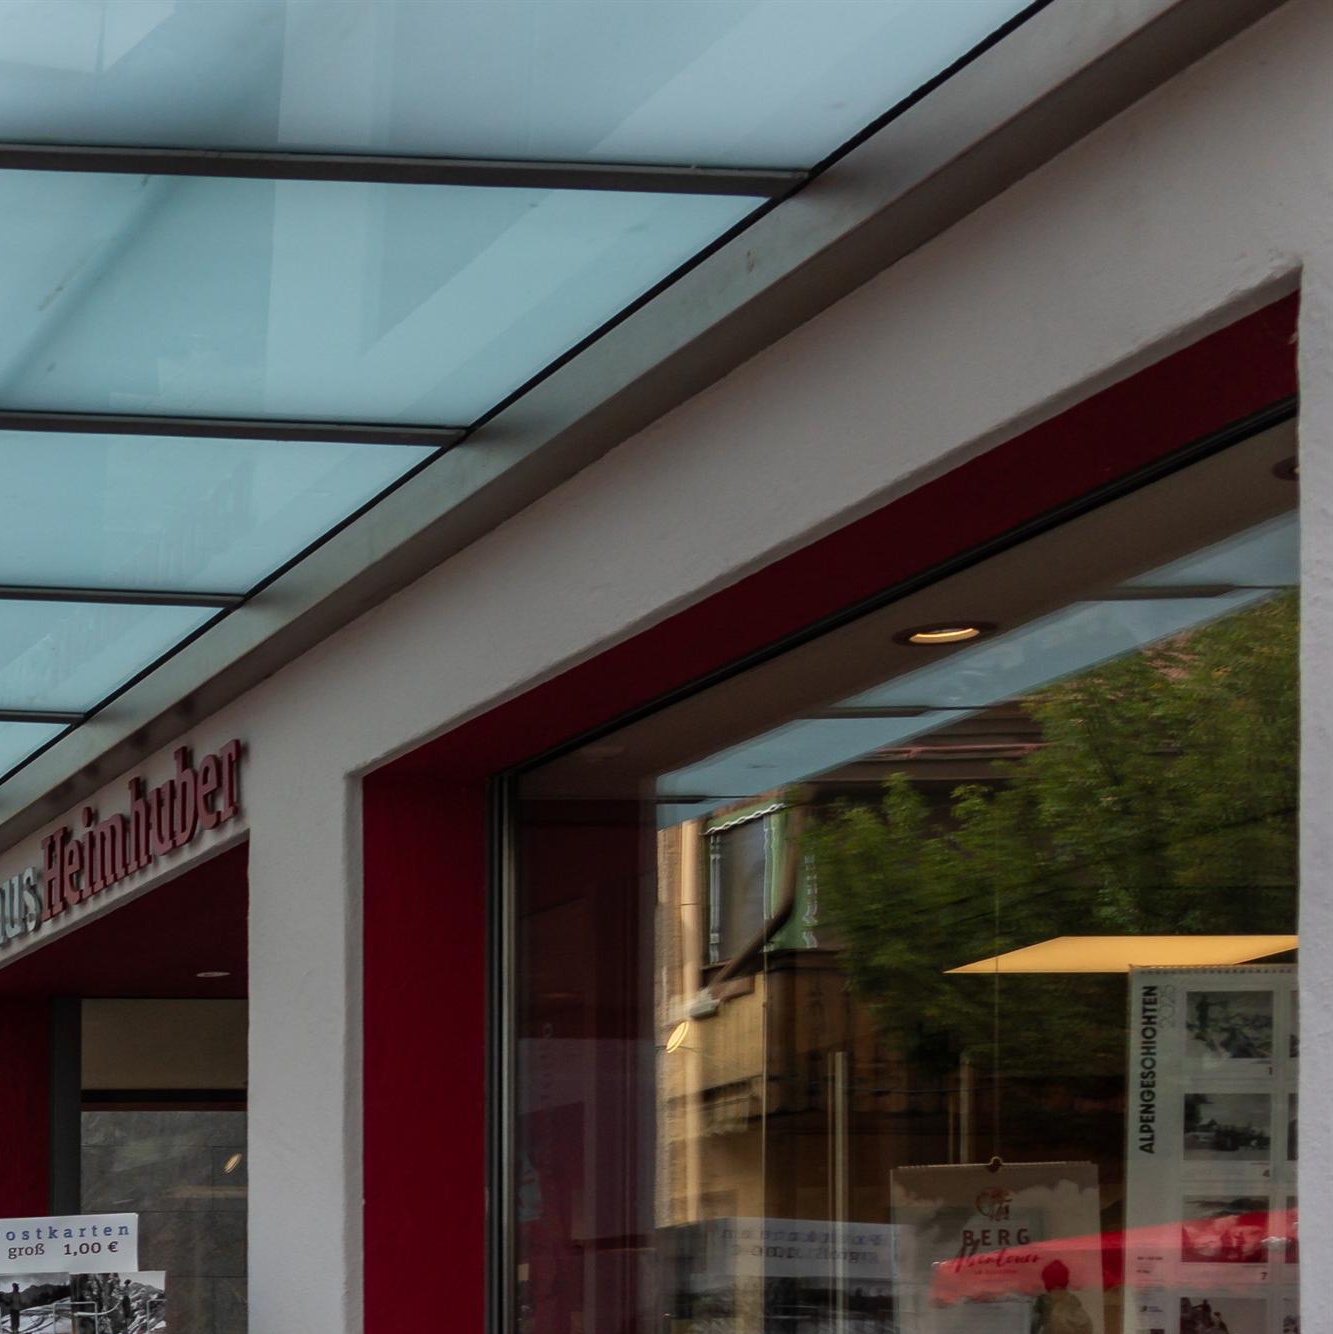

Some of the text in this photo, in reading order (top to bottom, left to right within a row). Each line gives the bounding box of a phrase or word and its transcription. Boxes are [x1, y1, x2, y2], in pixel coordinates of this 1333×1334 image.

[40, 739, 241, 922] Heimhuber
[962, 1228, 1030, 1246] BERG
[8, 1241, 119, 1260] groß 1,00 €
